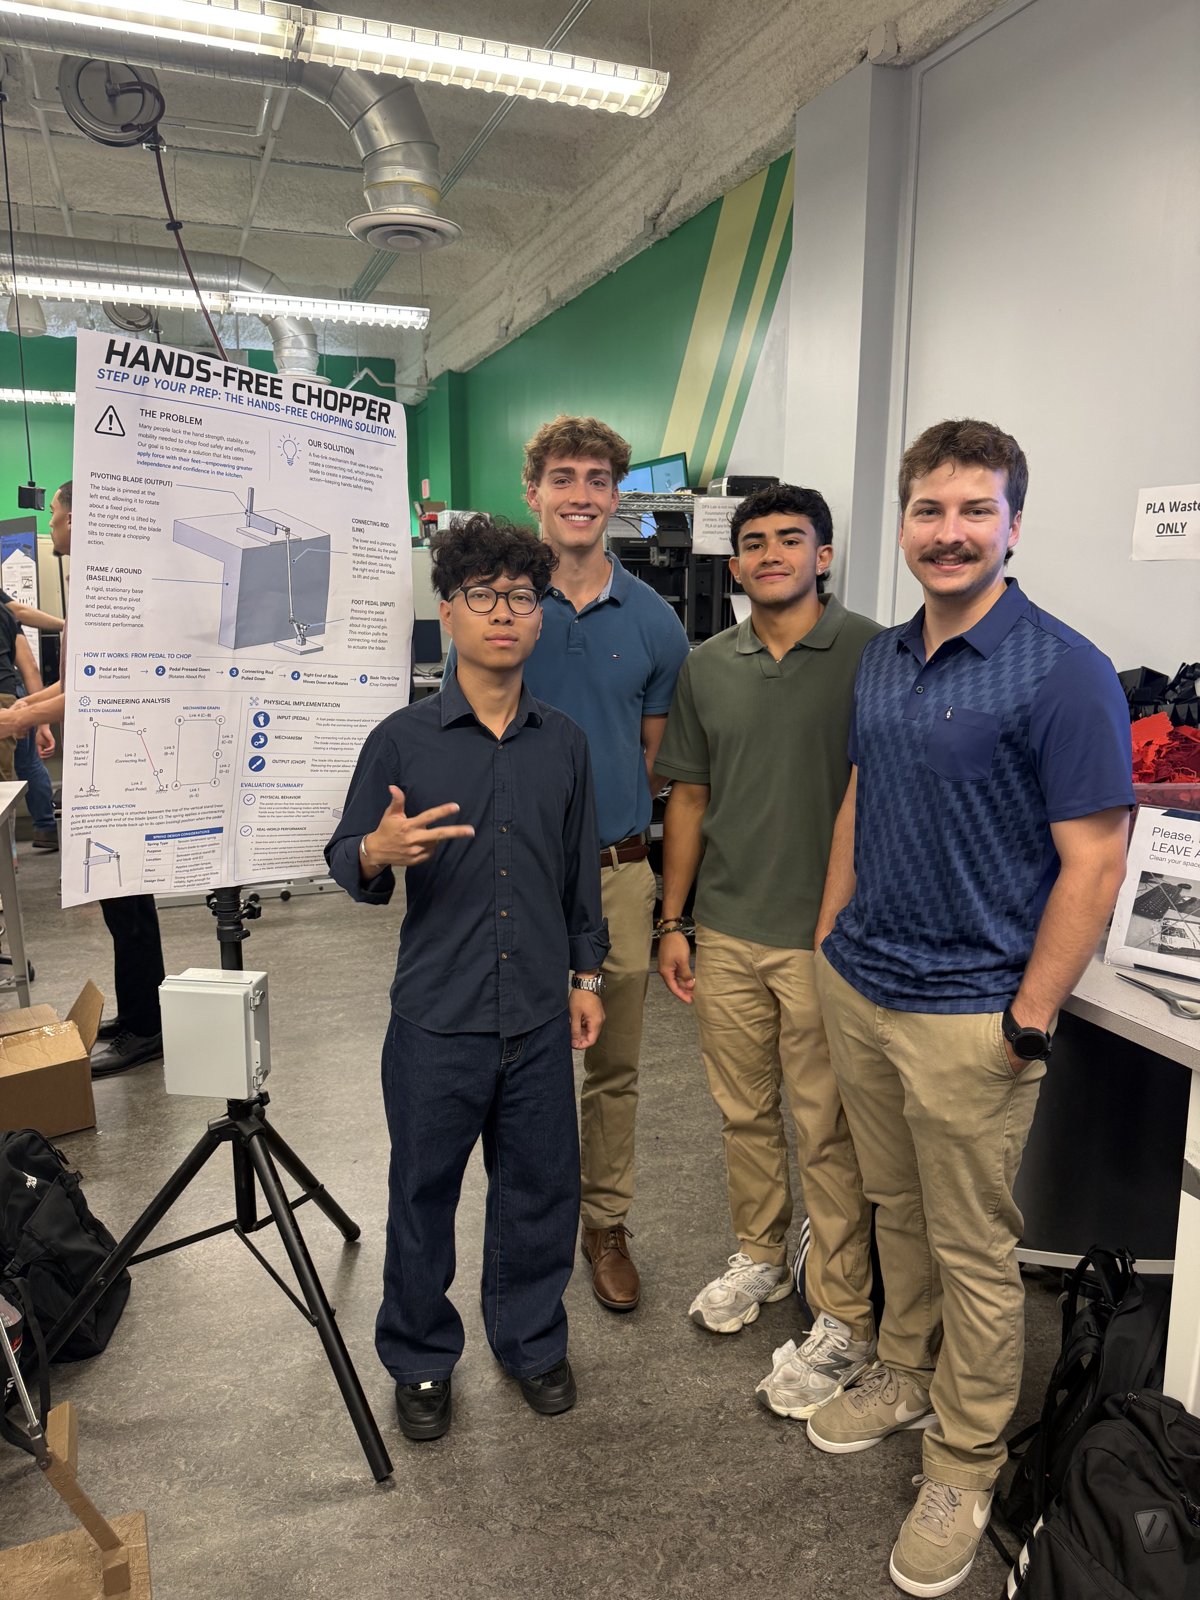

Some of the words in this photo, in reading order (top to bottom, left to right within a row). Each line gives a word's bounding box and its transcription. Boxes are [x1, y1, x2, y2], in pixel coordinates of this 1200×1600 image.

[104, 339, 283, 399] HANDS-FREE
[292, 383, 391, 424] CHOPPER
[97, 368, 129, 383] STEP
[133, 375, 149, 386] UP
[154, 378, 186, 393] YOUR
[190, 385, 221, 400] PREP:
[225, 392, 244, 406] THE
[248, 396, 308, 418] HANDS-FREE
[311, 411, 352, 429] CHOPPING
[355, 422, 396, 438] SOLUTION.
[140, 409, 156, 418] THE
[160, 412, 202, 426] PROBLEM
[138, 432, 157, 441] mobility
[234, 446, 256, 456] effectively
[205, 432, 226, 442] strength,
[308, 439, 322, 448] OUR
[324, 442, 354, 455] SOLUTION
[137, 460, 171, 469] independence
[183, 466, 210, 474] confidence
[91, 472, 121, 481] PIVOTING
[122, 475, 143, 484] BLADE
[144, 477, 173, 487] (OUTPUT)
[122, 487, 138, 495] pinned
[112, 495, 132, 505] allowing
[1146, 502, 1165, 514] PLA
[352, 518, 379, 527] CONNECTING
[1156, 522, 1187, 534] ONLY
[1152, 827, 1194, 843] Please,
[1152, 842, 1192, 857] LEAVE
